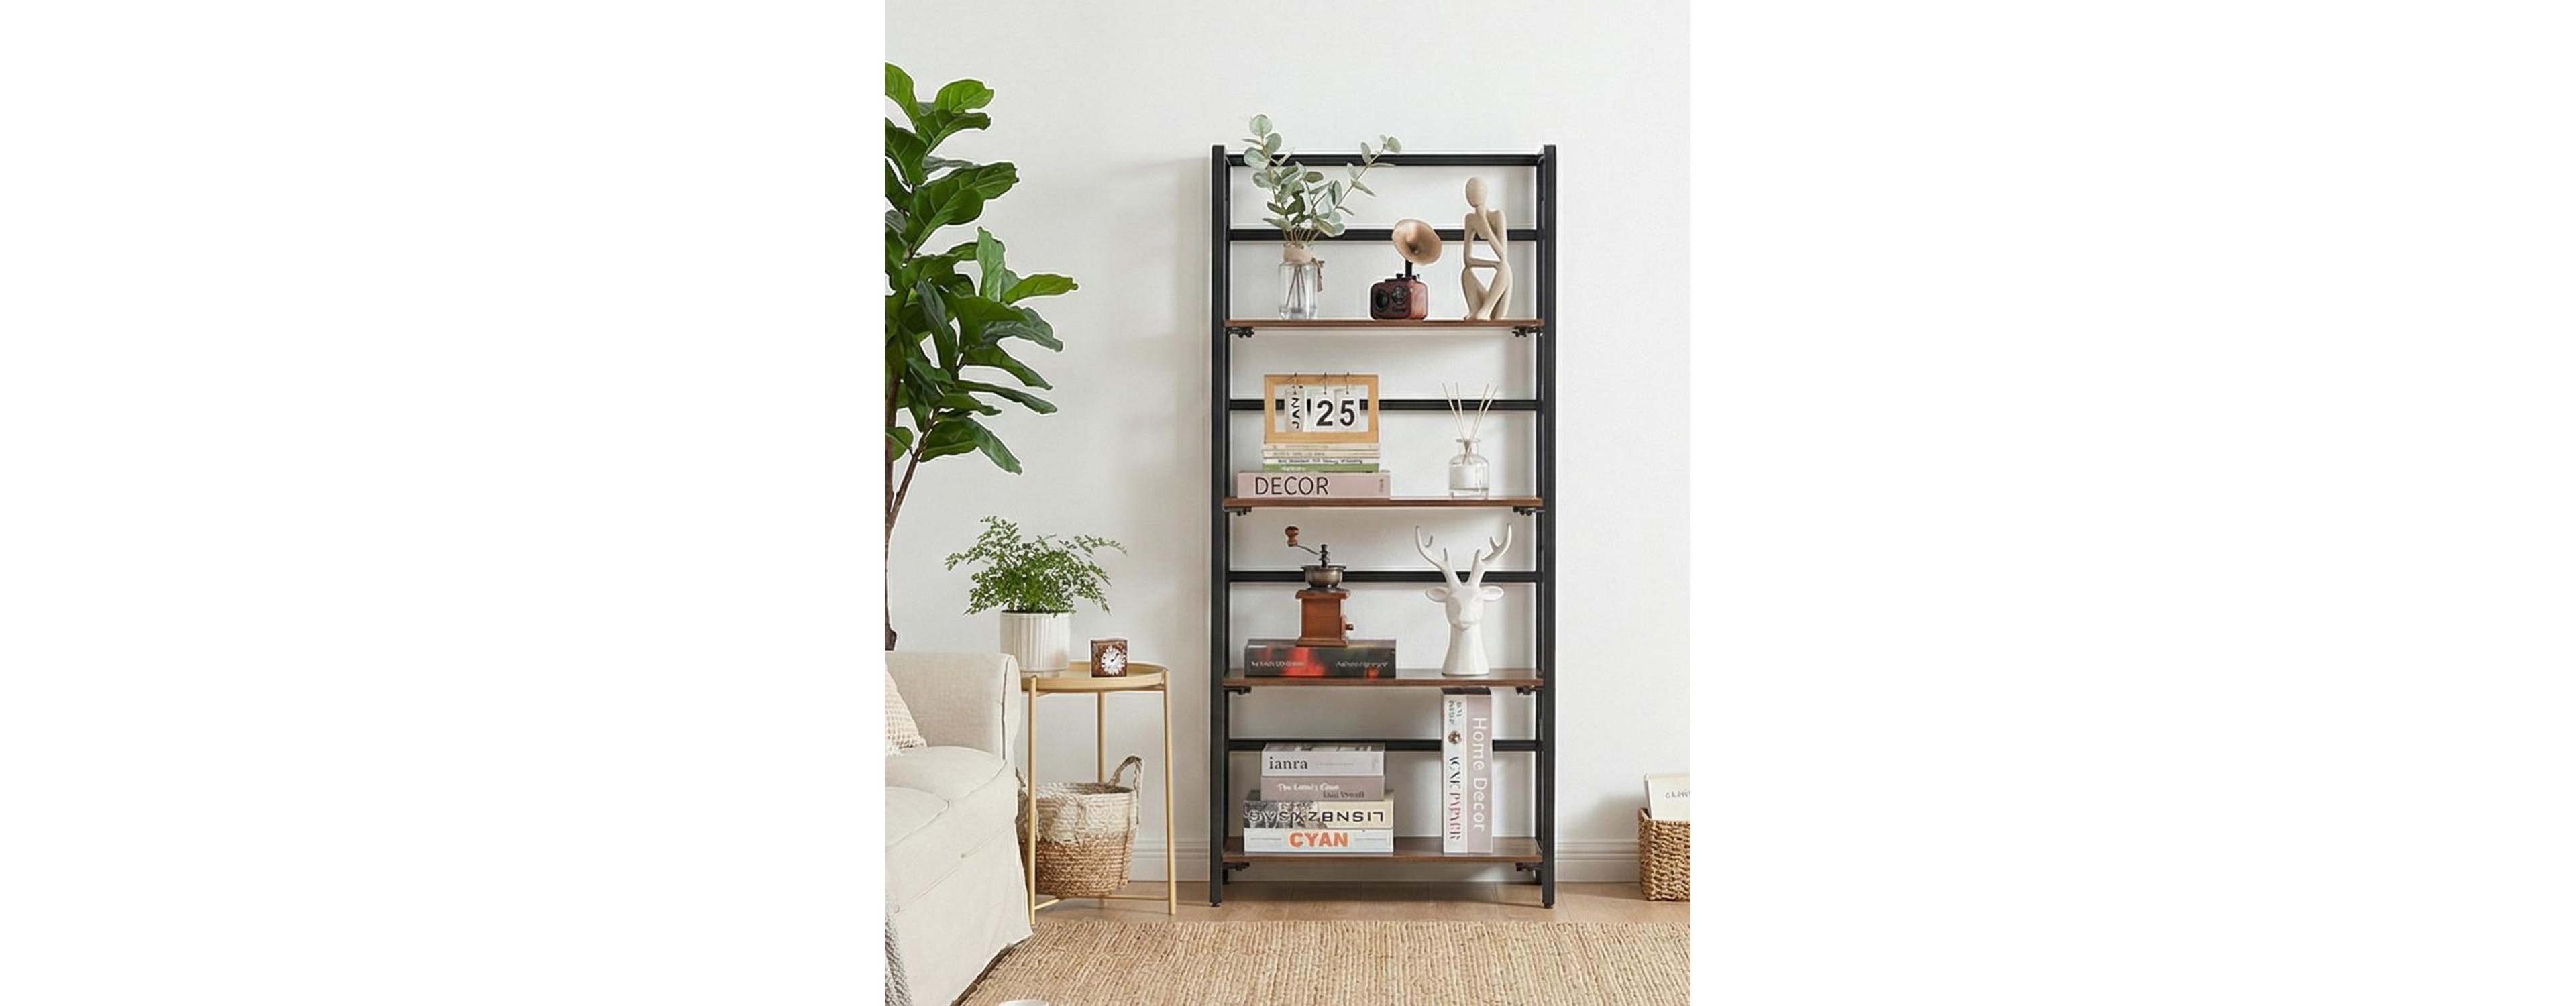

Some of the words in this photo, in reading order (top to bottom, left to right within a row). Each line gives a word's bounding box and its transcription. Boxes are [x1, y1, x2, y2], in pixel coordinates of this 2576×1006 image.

[1291, 397, 1300, 429] JAN
[1316, 400, 1355, 427] 25
[1255, 476, 1329, 495] DECOR
[1472, 718, 1487, 771] Home
[1269, 756, 1308, 770] ianra
[1473, 777, 1487, 832] Decor
[1289, 832, 1348, 848] CYAN
